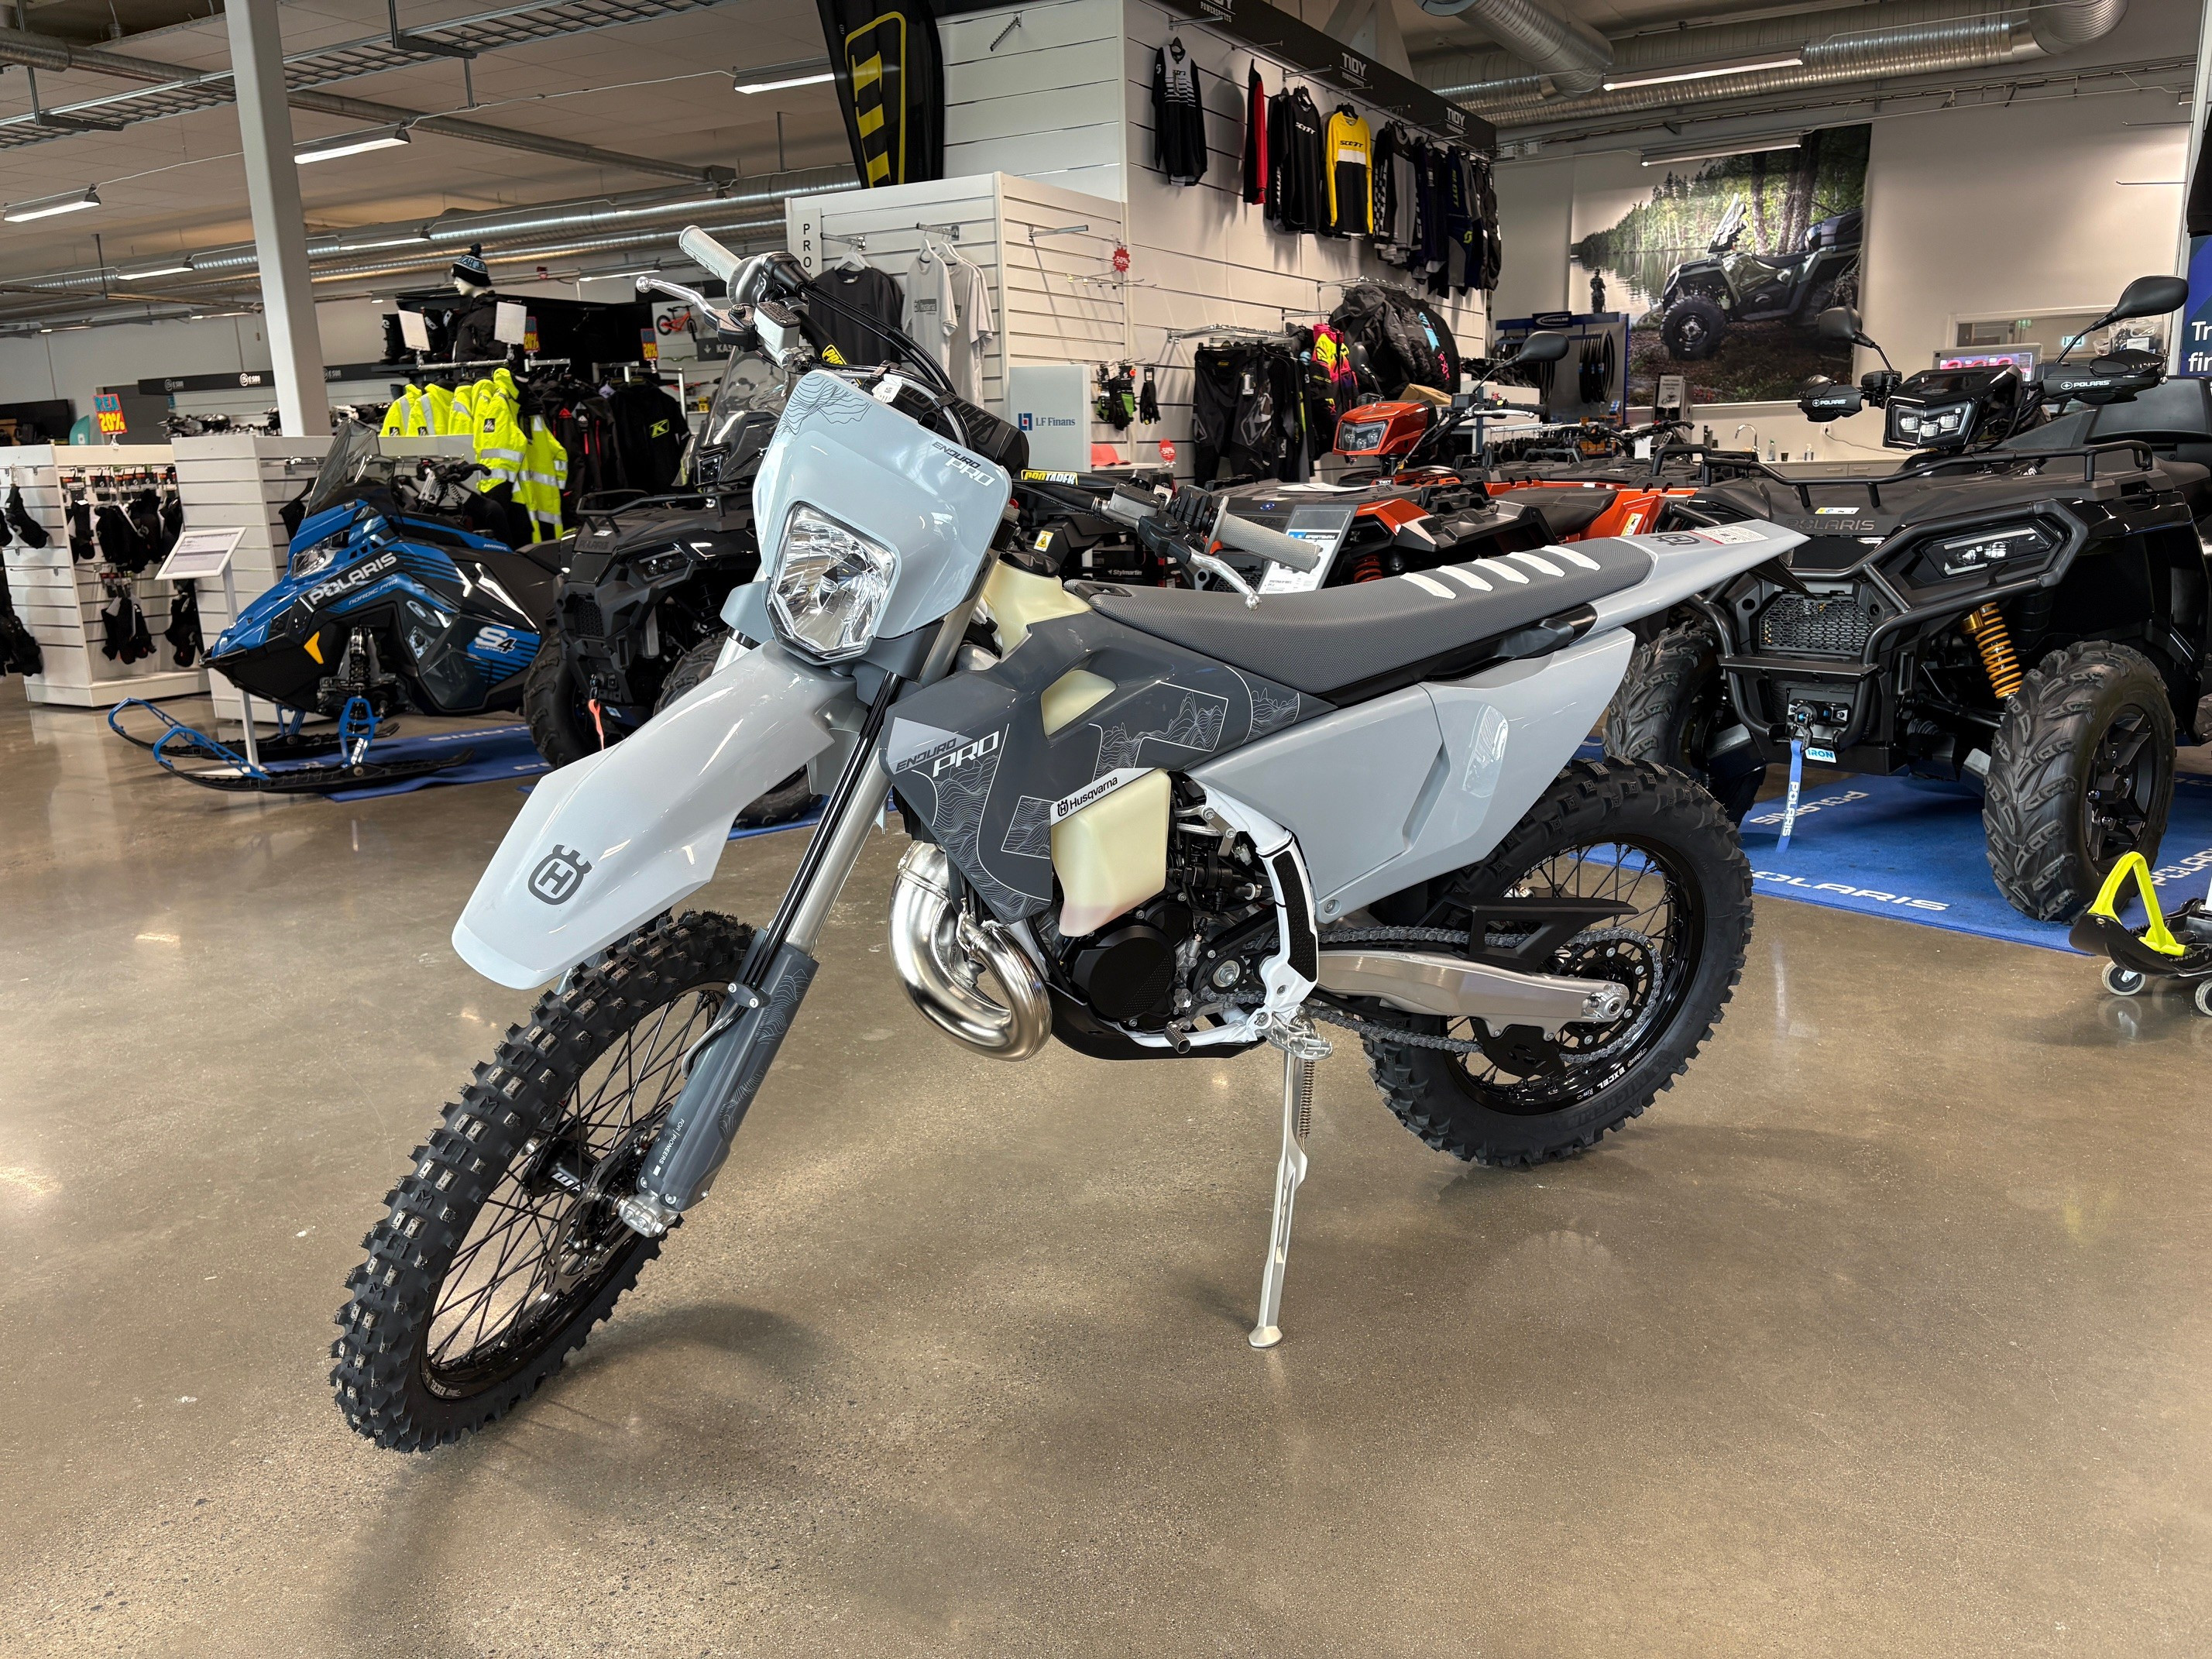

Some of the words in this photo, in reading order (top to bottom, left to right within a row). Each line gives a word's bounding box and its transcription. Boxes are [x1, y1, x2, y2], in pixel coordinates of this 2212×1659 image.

[1341, 52, 1367, 77] TIDY
[1295, 122, 1316, 135] SCOTT
[1445, 106, 1465, 127] TIDY
[1339, 140, 1364, 149] SCOTT
[2073, 380, 2111, 388] POLARIS
[94, 396, 120, 412] REA
[98, 412, 125, 431] 20%
[1036, 417, 1046, 426] LF
[1048, 417, 1076, 426] Finans
[932, 441, 981, 469] ENDURO
[945, 455, 996, 486] PRO
[1784, 517, 1875, 531] POLARIS
[309, 552, 397, 605] POLARIS
[349, 588, 378, 606] NORDIC
[380, 578, 397, 589] PRO
[896, 737, 957, 772] ENDURO
[933, 730, 999, 778] PRO
[1807, 749, 1833, 758] IRON
[1070, 777, 1118, 811] Husqvarna
[1781, 781, 1800, 836] POLARIS
[1750, 869, 1950, 911] OLARIS
[1597, 1066, 1626, 1089] EXCEL
[659, 1134, 678, 1165] PIONEERS
